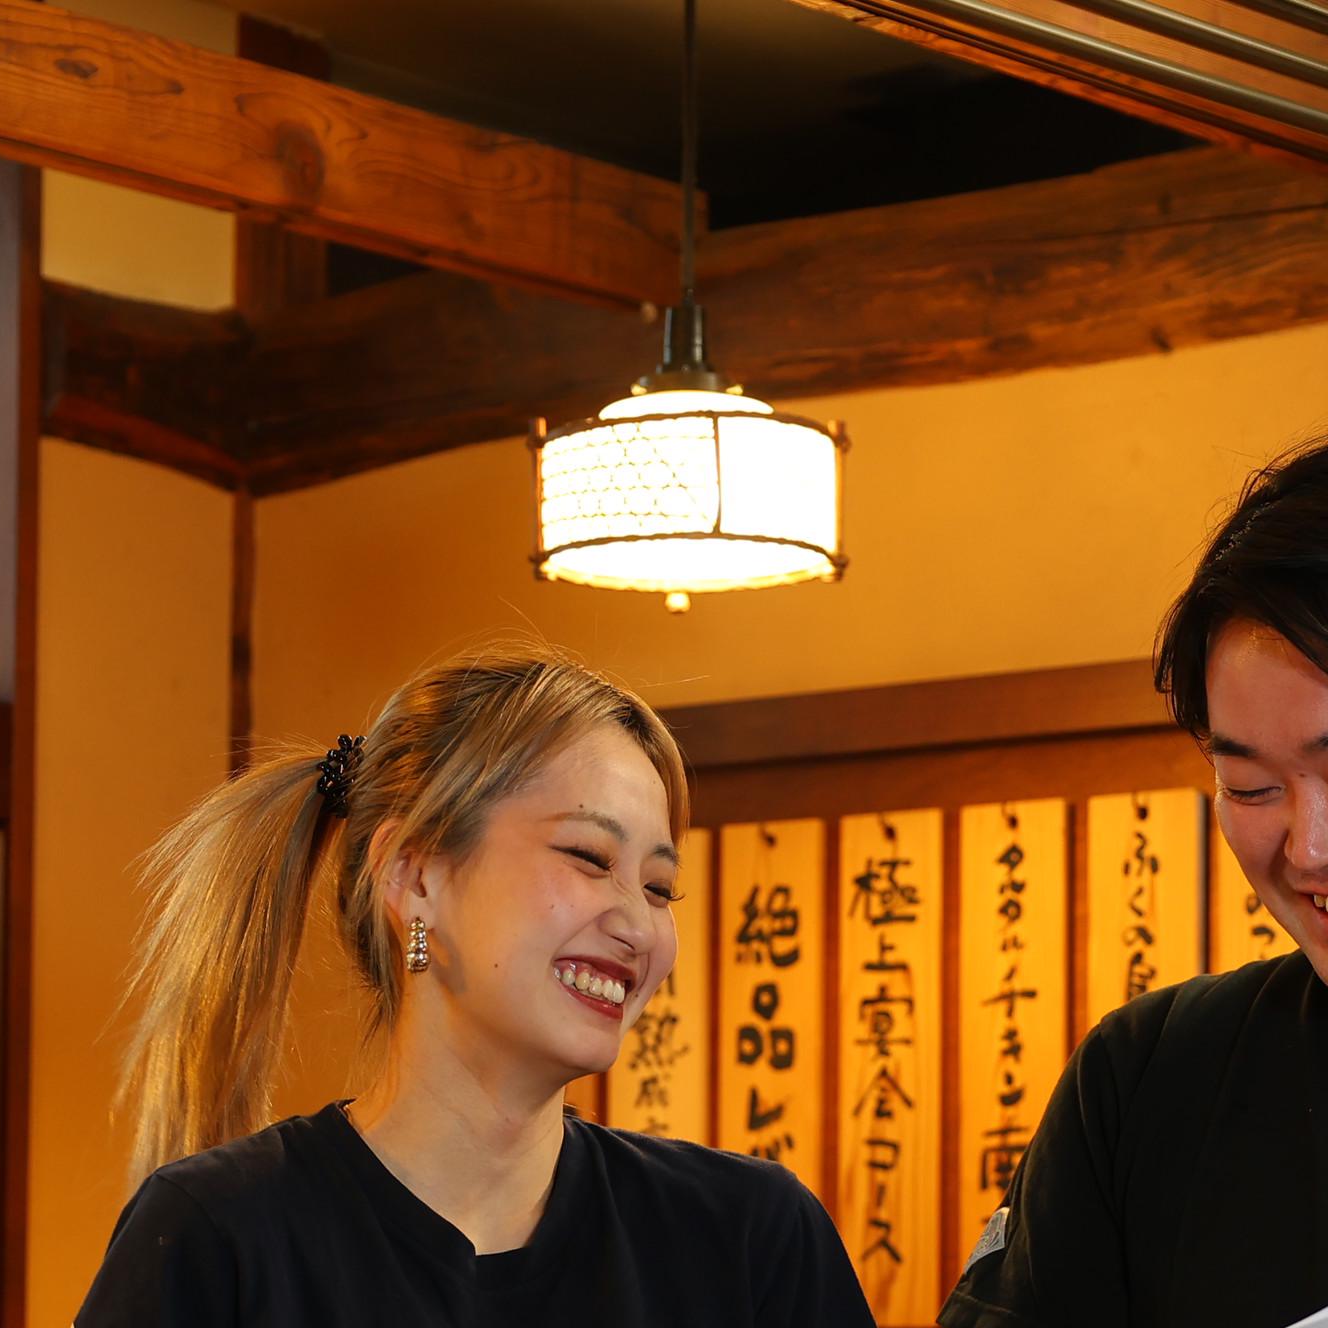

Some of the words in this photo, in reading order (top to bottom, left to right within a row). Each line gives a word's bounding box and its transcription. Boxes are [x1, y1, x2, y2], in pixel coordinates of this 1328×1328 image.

[847, 857, 922, 1265] 極上宴会コース
